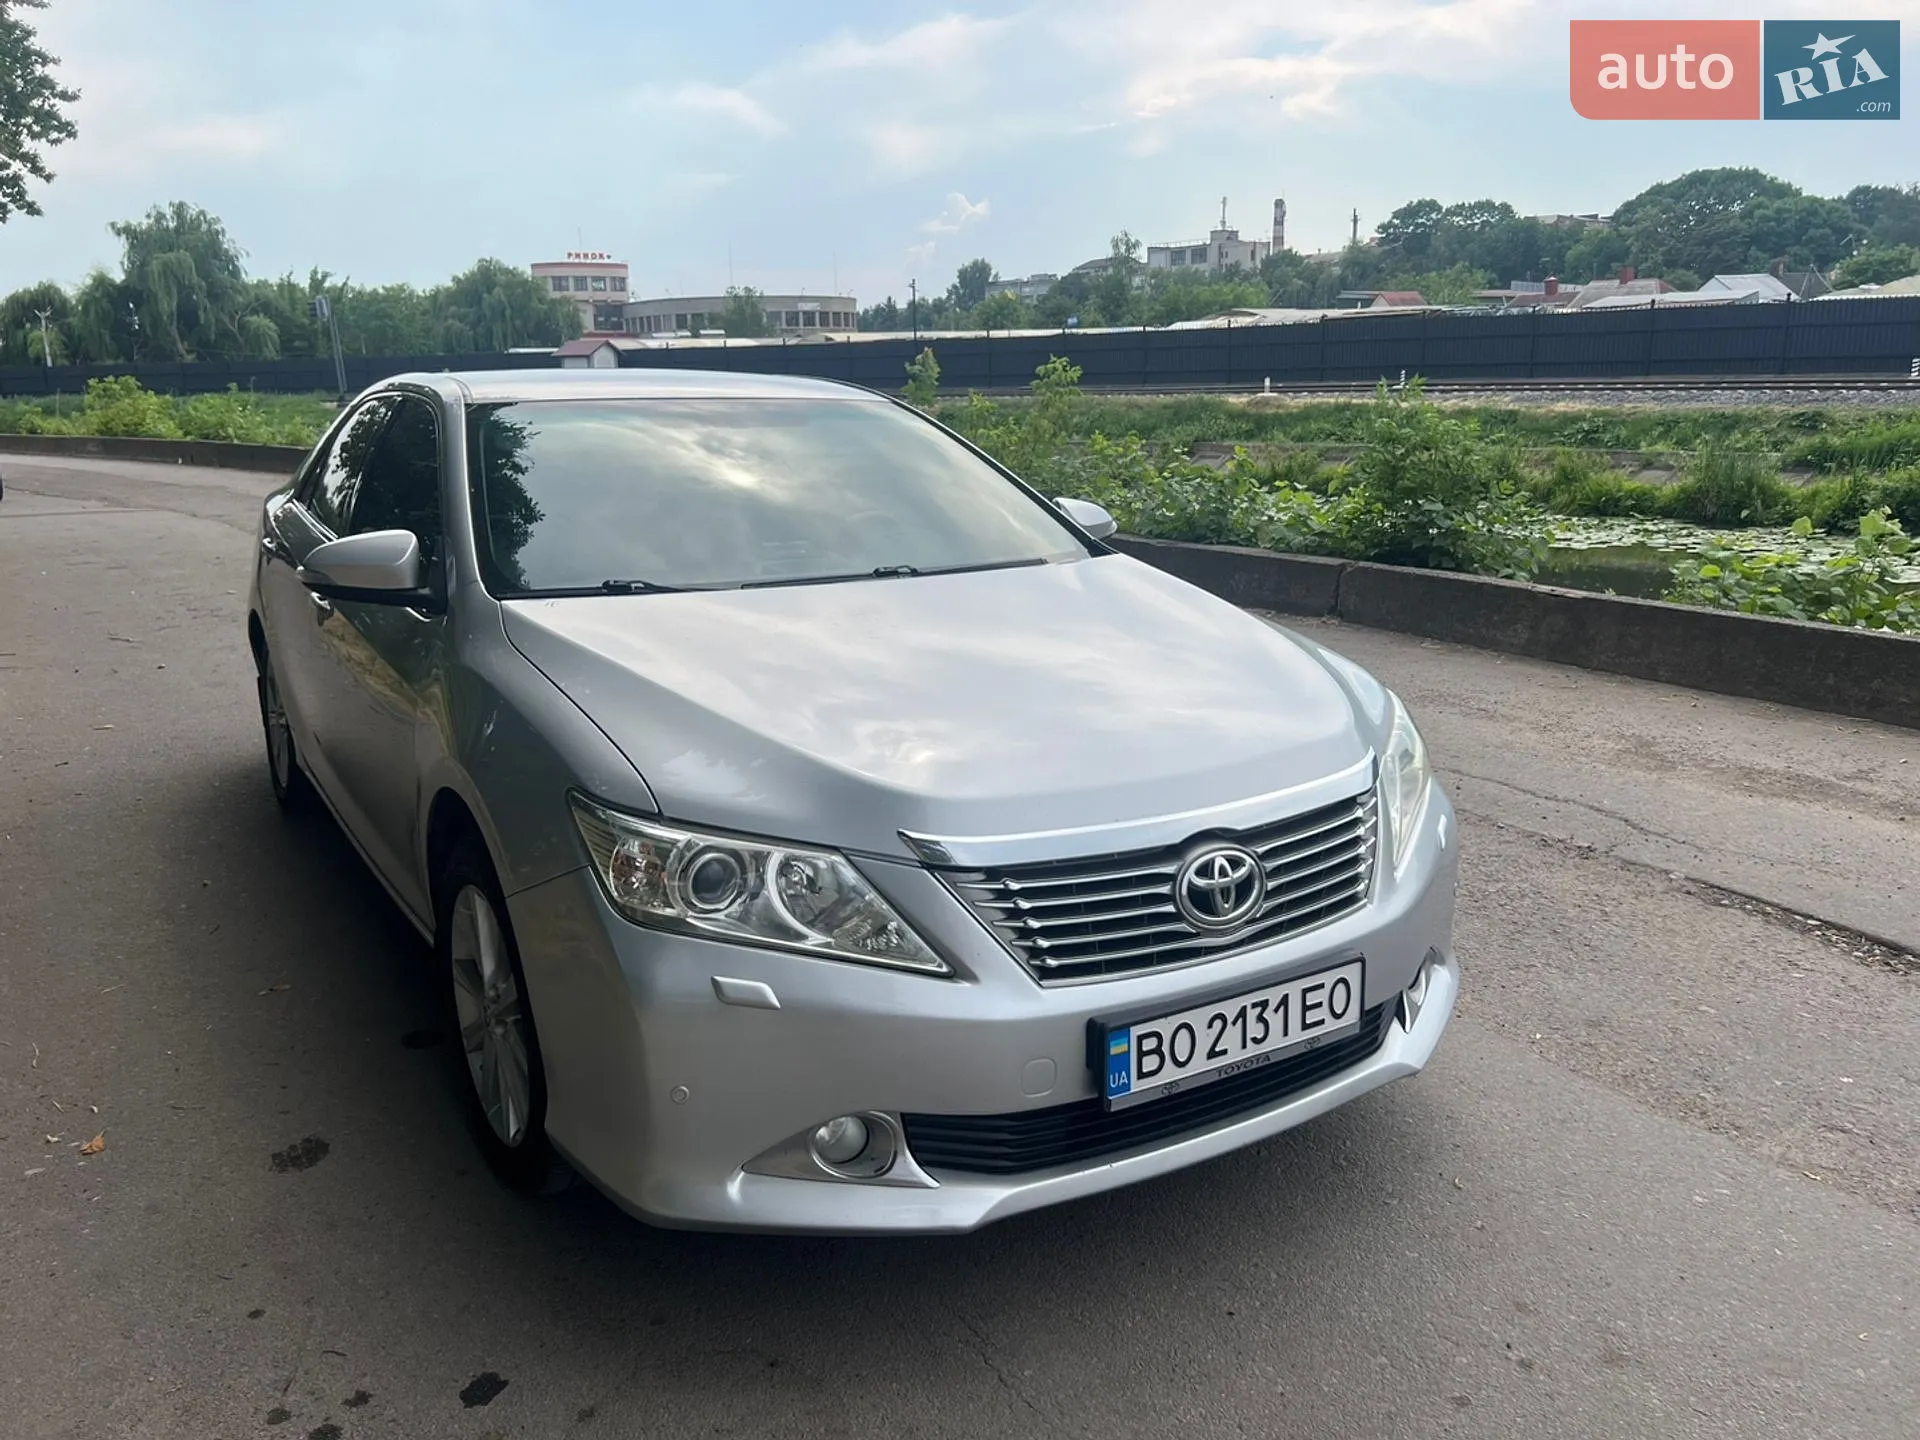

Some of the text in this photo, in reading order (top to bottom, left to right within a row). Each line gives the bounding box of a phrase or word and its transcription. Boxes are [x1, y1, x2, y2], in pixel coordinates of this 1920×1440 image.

[1136, 976, 1352, 1081] BO 2131 EO
[1216, 1054, 1273, 1078] TOYOTA
[1110, 1072, 1128, 1089] UA
